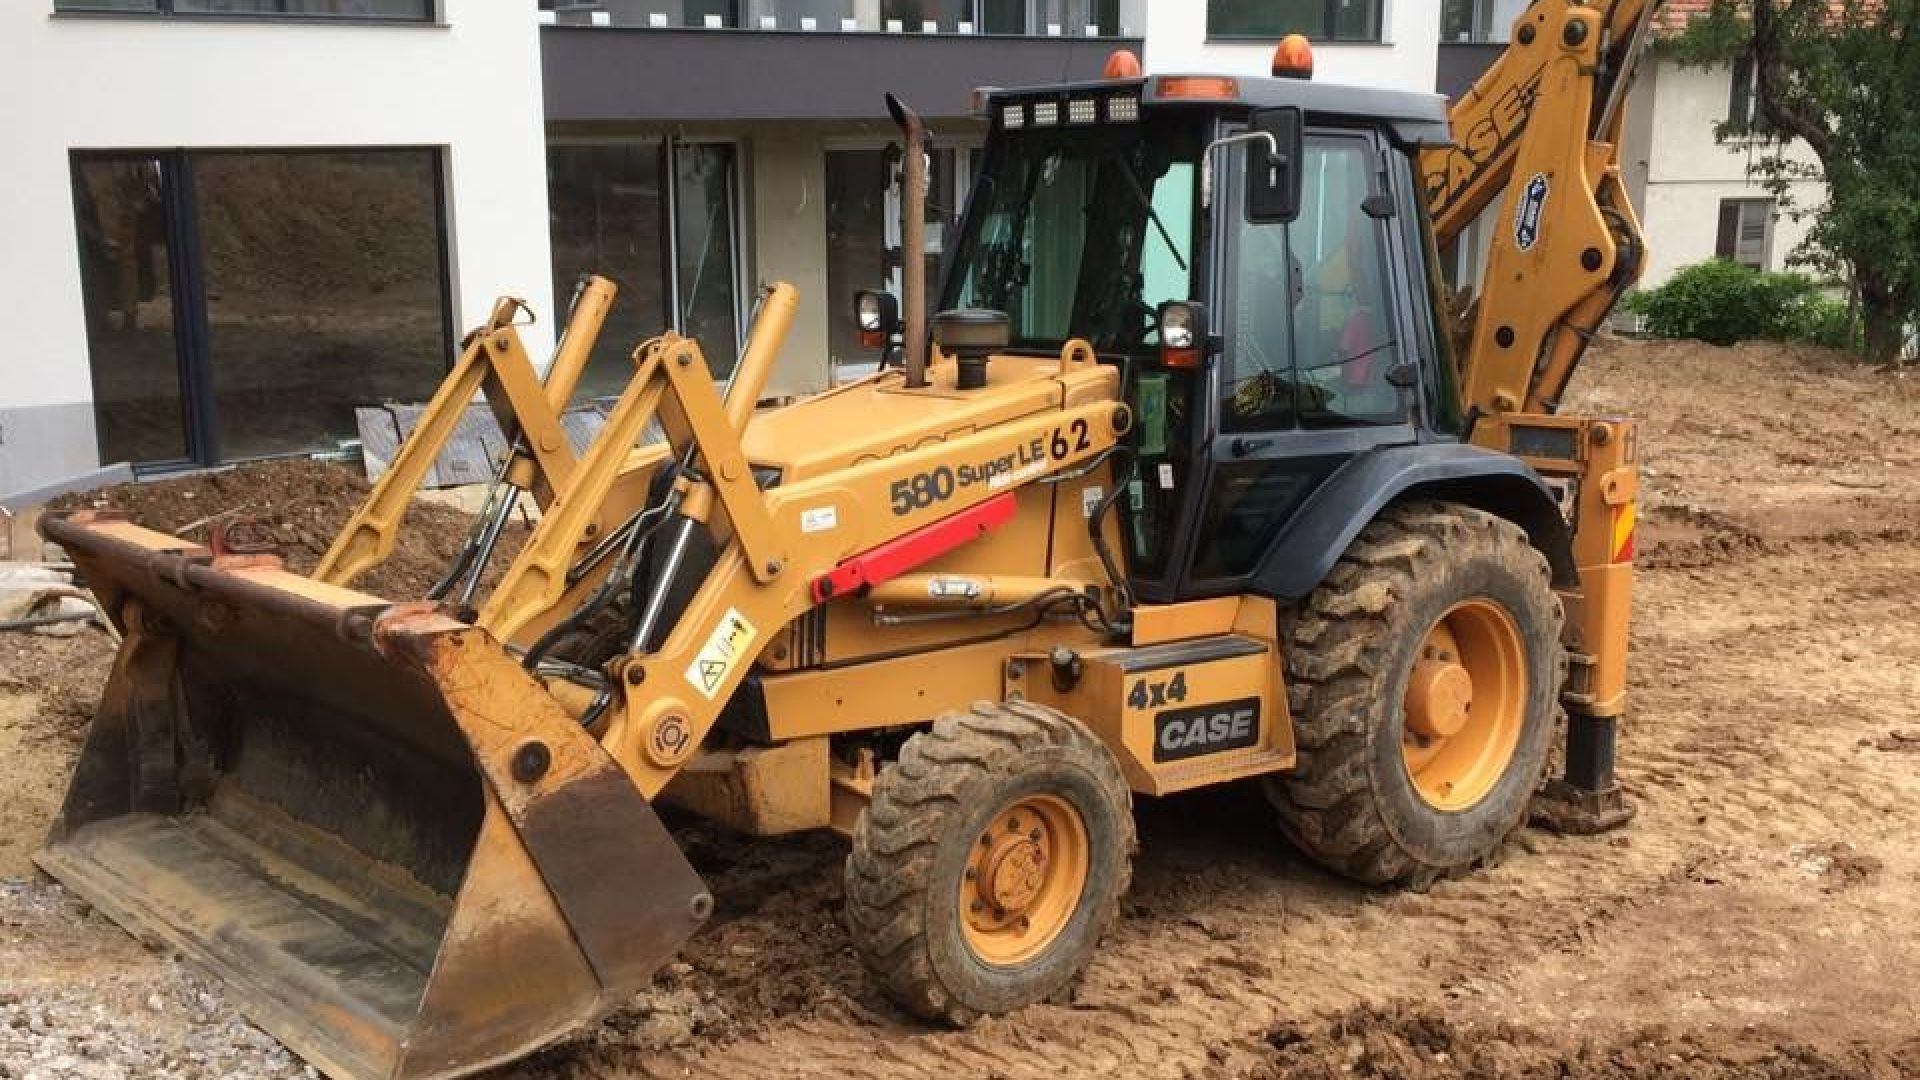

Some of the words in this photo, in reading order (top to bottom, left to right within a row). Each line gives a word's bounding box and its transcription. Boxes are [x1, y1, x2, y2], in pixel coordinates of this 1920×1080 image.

[1424, 80, 1535, 222] CASE
[1051, 418, 1091, 460] 62
[890, 465, 955, 516] 580
[957, 453, 1016, 487] Super
[1018, 438, 1046, 465] LE
[1128, 671, 1187, 710] 4x4
[1160, 709, 1253, 749] CASE
